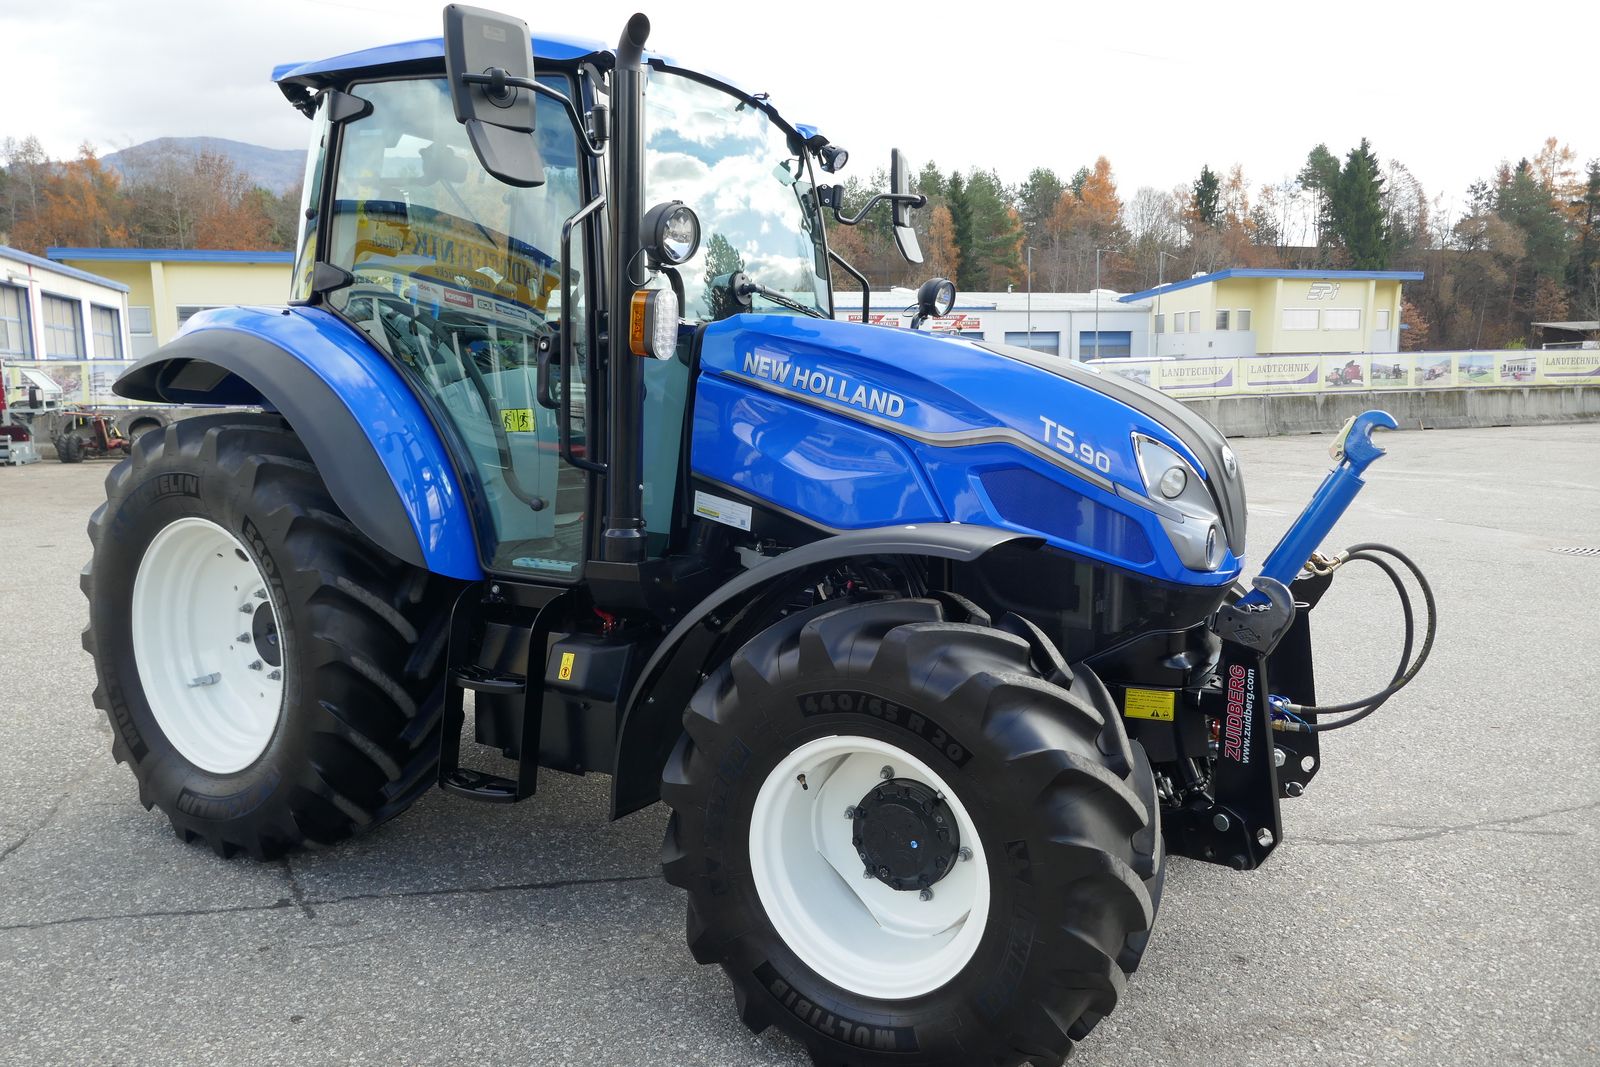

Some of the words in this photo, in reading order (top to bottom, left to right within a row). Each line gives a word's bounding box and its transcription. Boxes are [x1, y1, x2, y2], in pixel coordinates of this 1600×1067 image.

[743, 352, 791, 383] NEW
[792, 366, 904, 418] HOLLAND
[1161, 366, 1224, 377] LANDTECHNIK
[1250, 363, 1310, 374] LANDTECHNIK
[1546, 357, 1600, 366] LANDTECHNIK
[1040, 415, 1111, 473] T5.90
[804, 693, 898, 720] 440/65
[908, 712, 926, 734] R
[932, 728, 964, 762] 20
[1225, 665, 1246, 761] ZUIDBERG
[1242, 668, 1255, 764] www.zuidberg.com
[769, 978, 896, 1048] MULTIBIB
